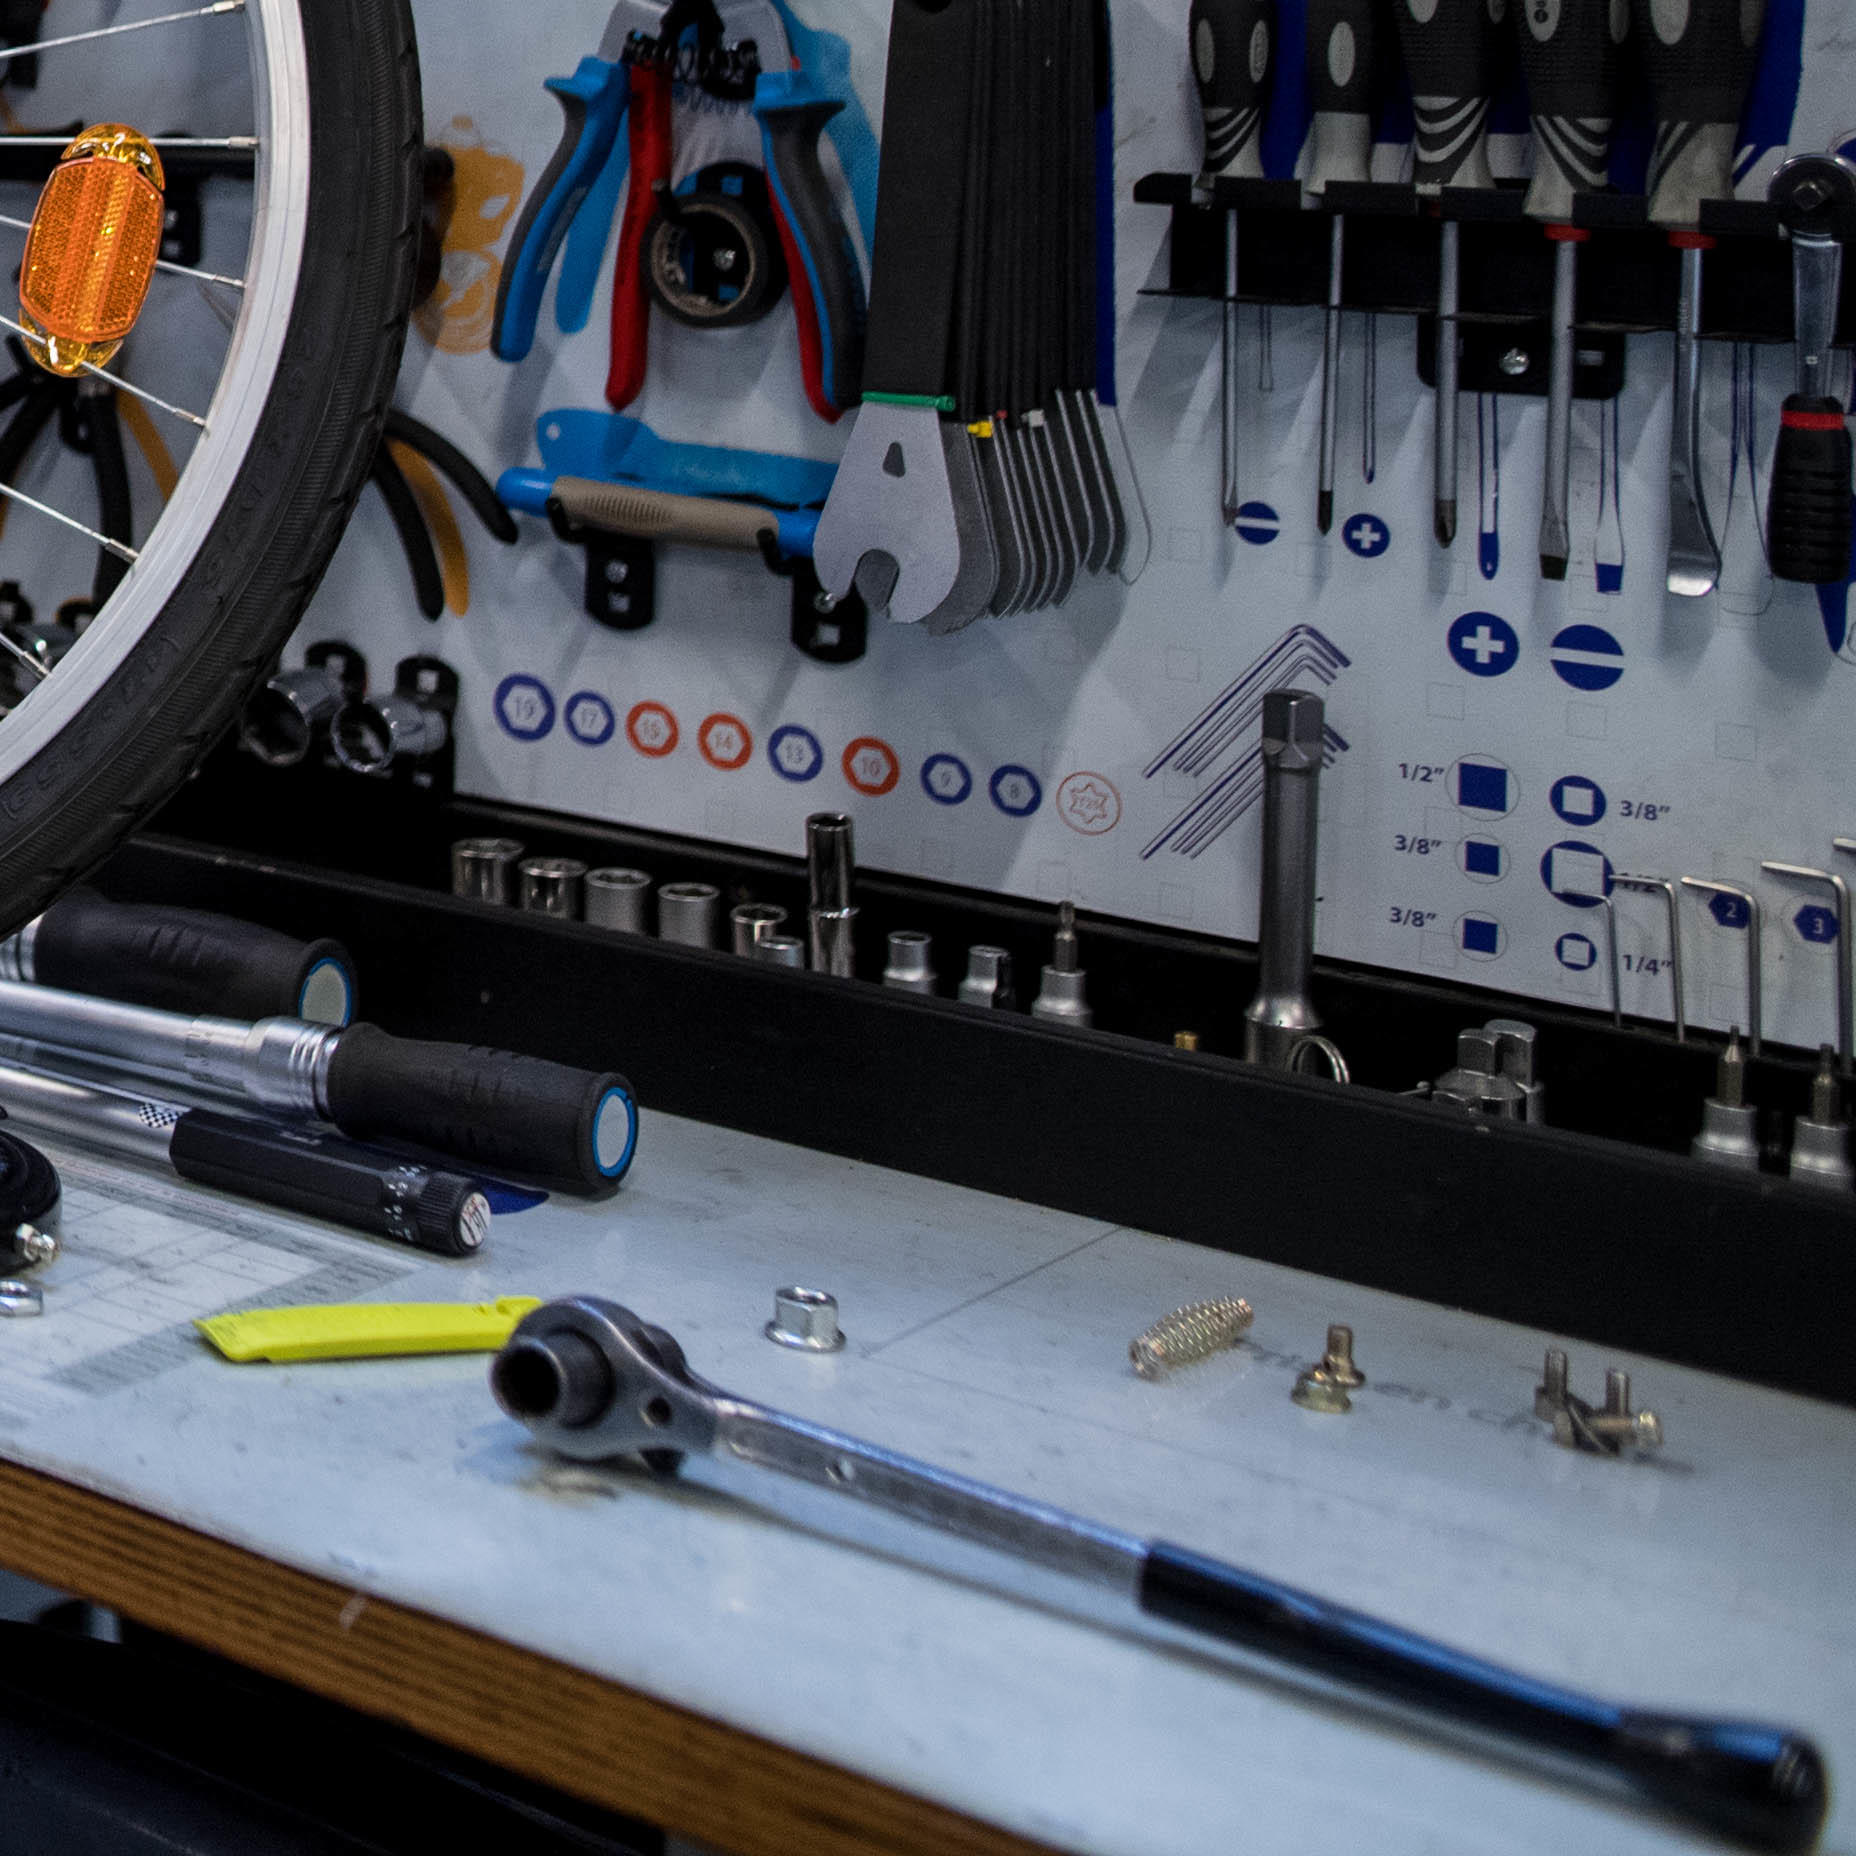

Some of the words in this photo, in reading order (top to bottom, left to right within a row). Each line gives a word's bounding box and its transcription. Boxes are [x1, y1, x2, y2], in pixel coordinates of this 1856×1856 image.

[1398, 762, 1445, 783] 1/2"
[1619, 800, 1672, 822] 3/8"
[1393, 834, 1443, 856] 3/8"
[1389, 907, 1437, 929] 3/8"
[1726, 901, 1737, 918] 2
[1811, 917, 1825, 935] 3
[1622, 953, 1673, 977] 1/4"
